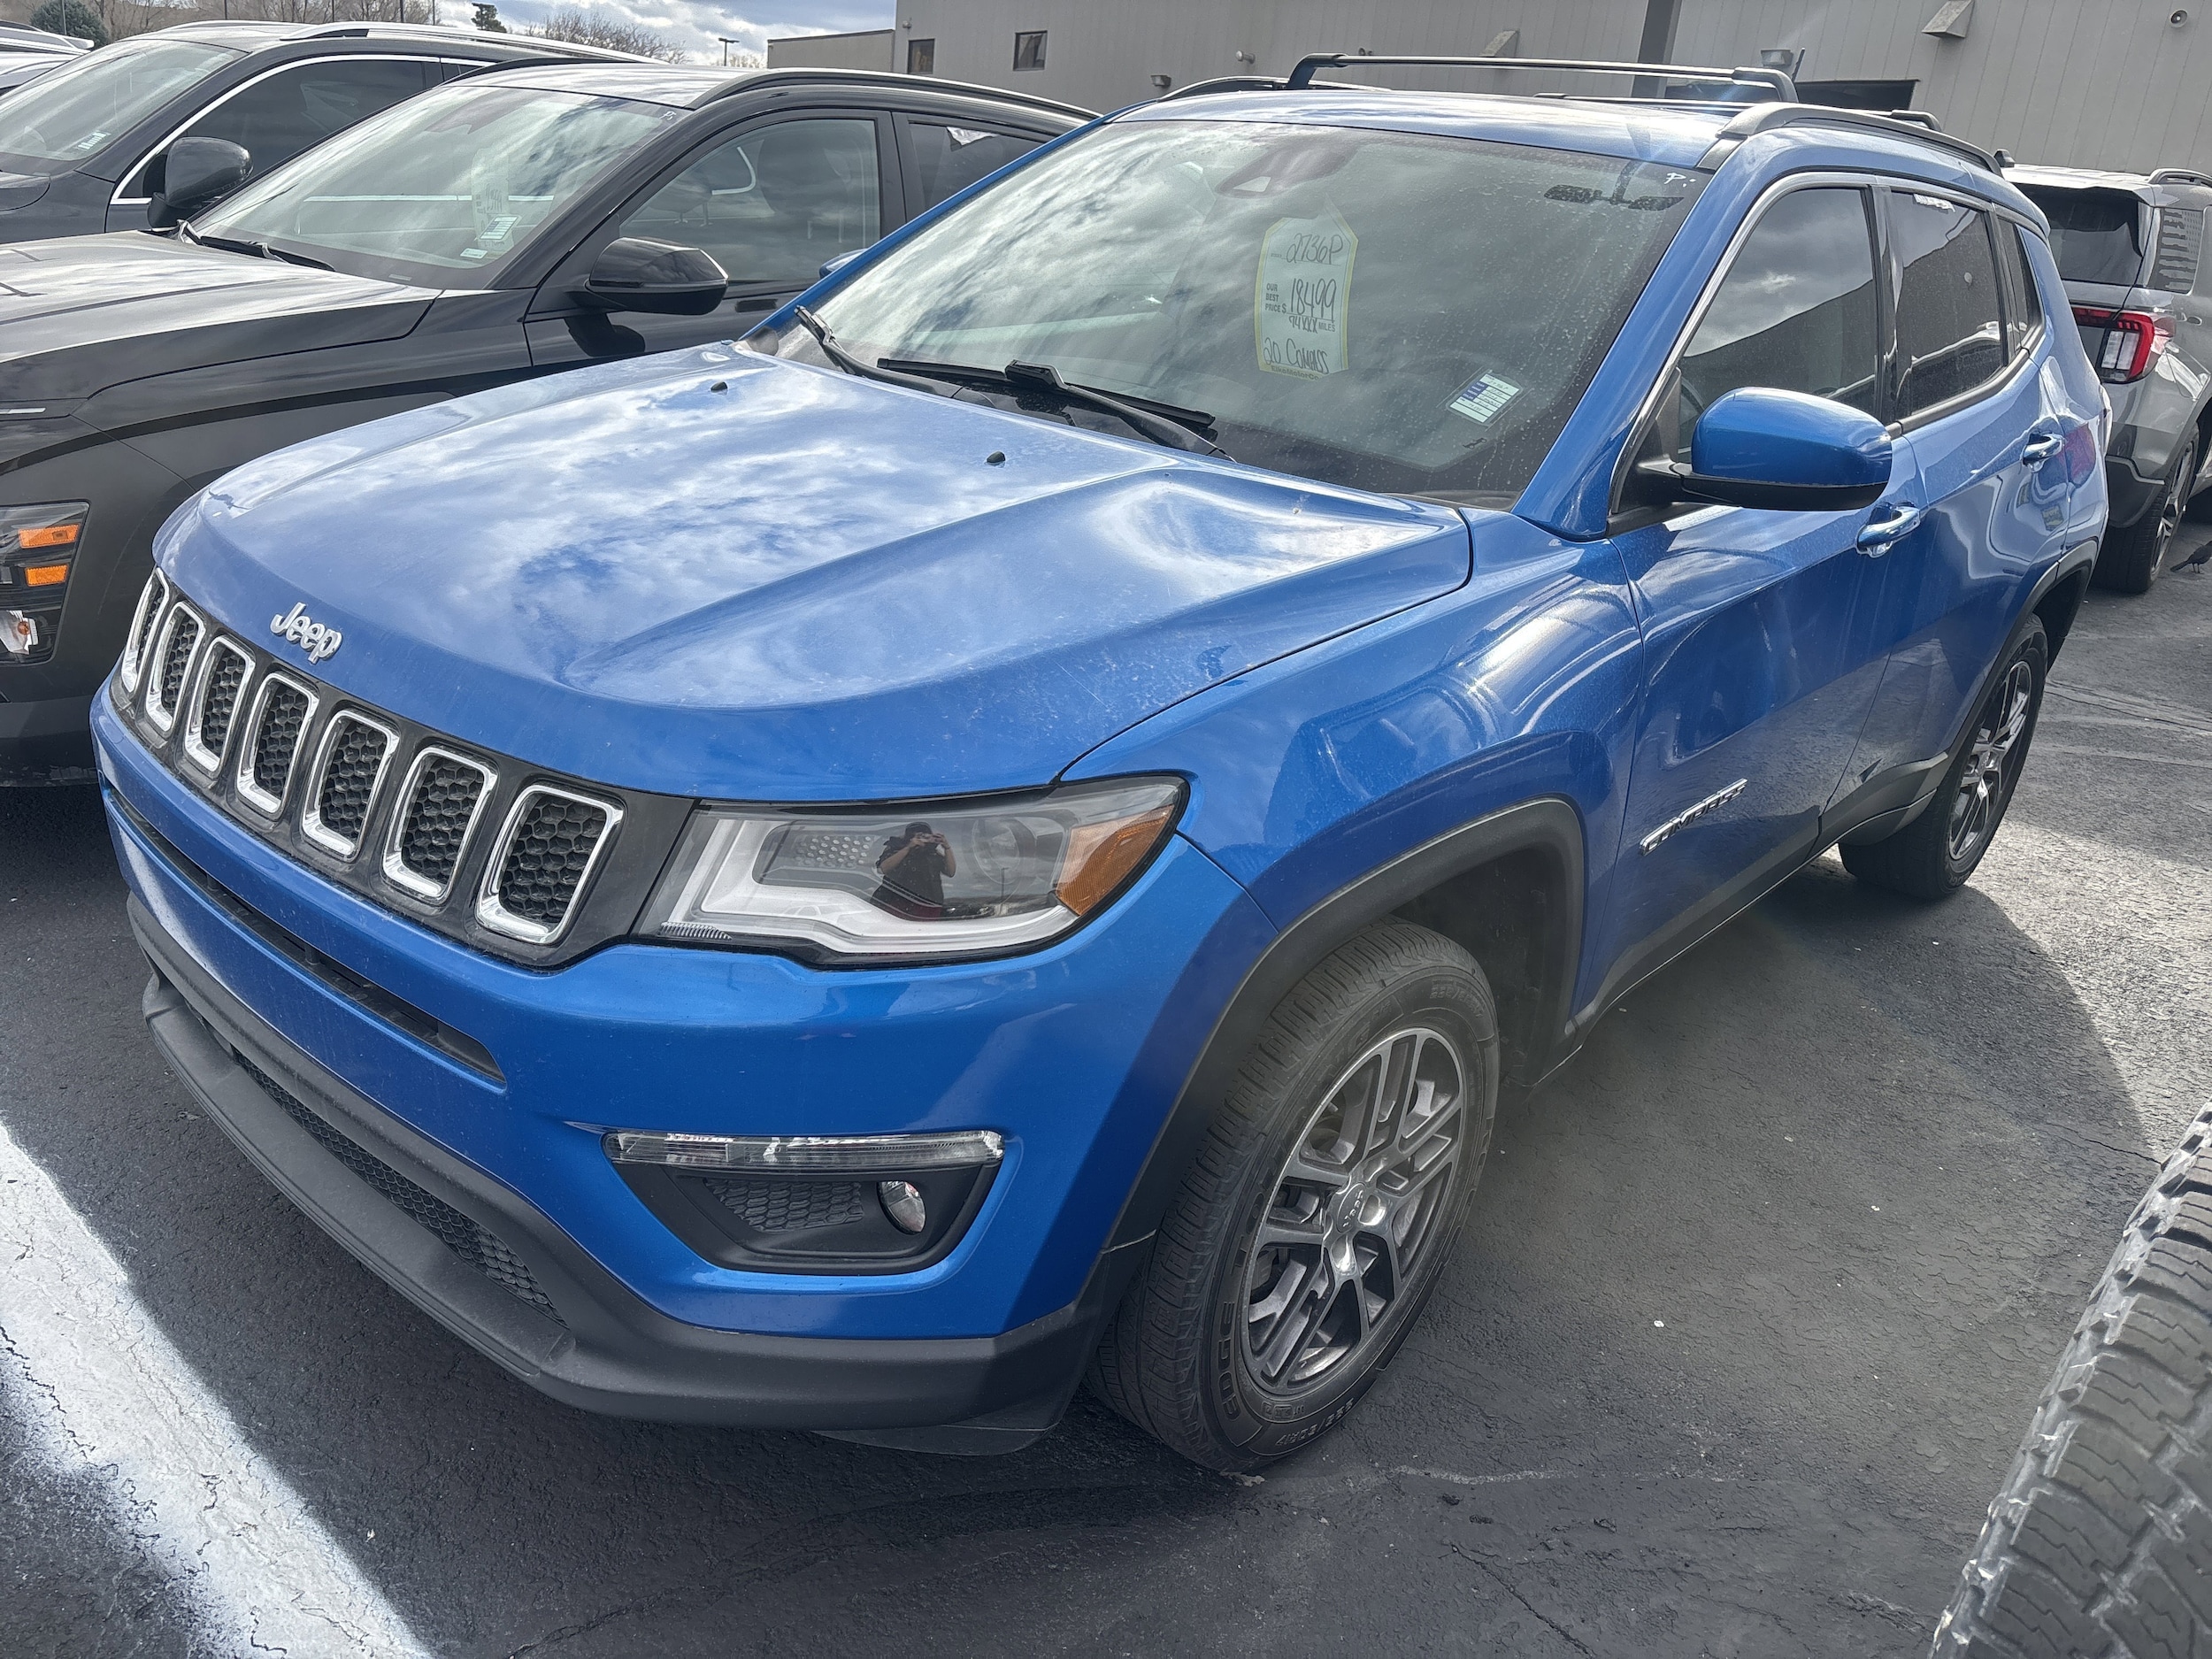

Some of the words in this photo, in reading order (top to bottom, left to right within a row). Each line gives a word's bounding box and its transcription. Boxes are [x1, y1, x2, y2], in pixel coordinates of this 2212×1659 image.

[1286, 233, 1343, 265] 2736P
[1265, 293, 1279, 302] BEST
[1266, 282, 1278, 291] OUR
[1264, 303, 1280, 312] PRICE
[1291, 278, 1337, 324] 18499
[1318, 322, 1336, 333] MILES
[1263, 337, 1281, 365] 20
[270, 602, 342, 664] Jeep
